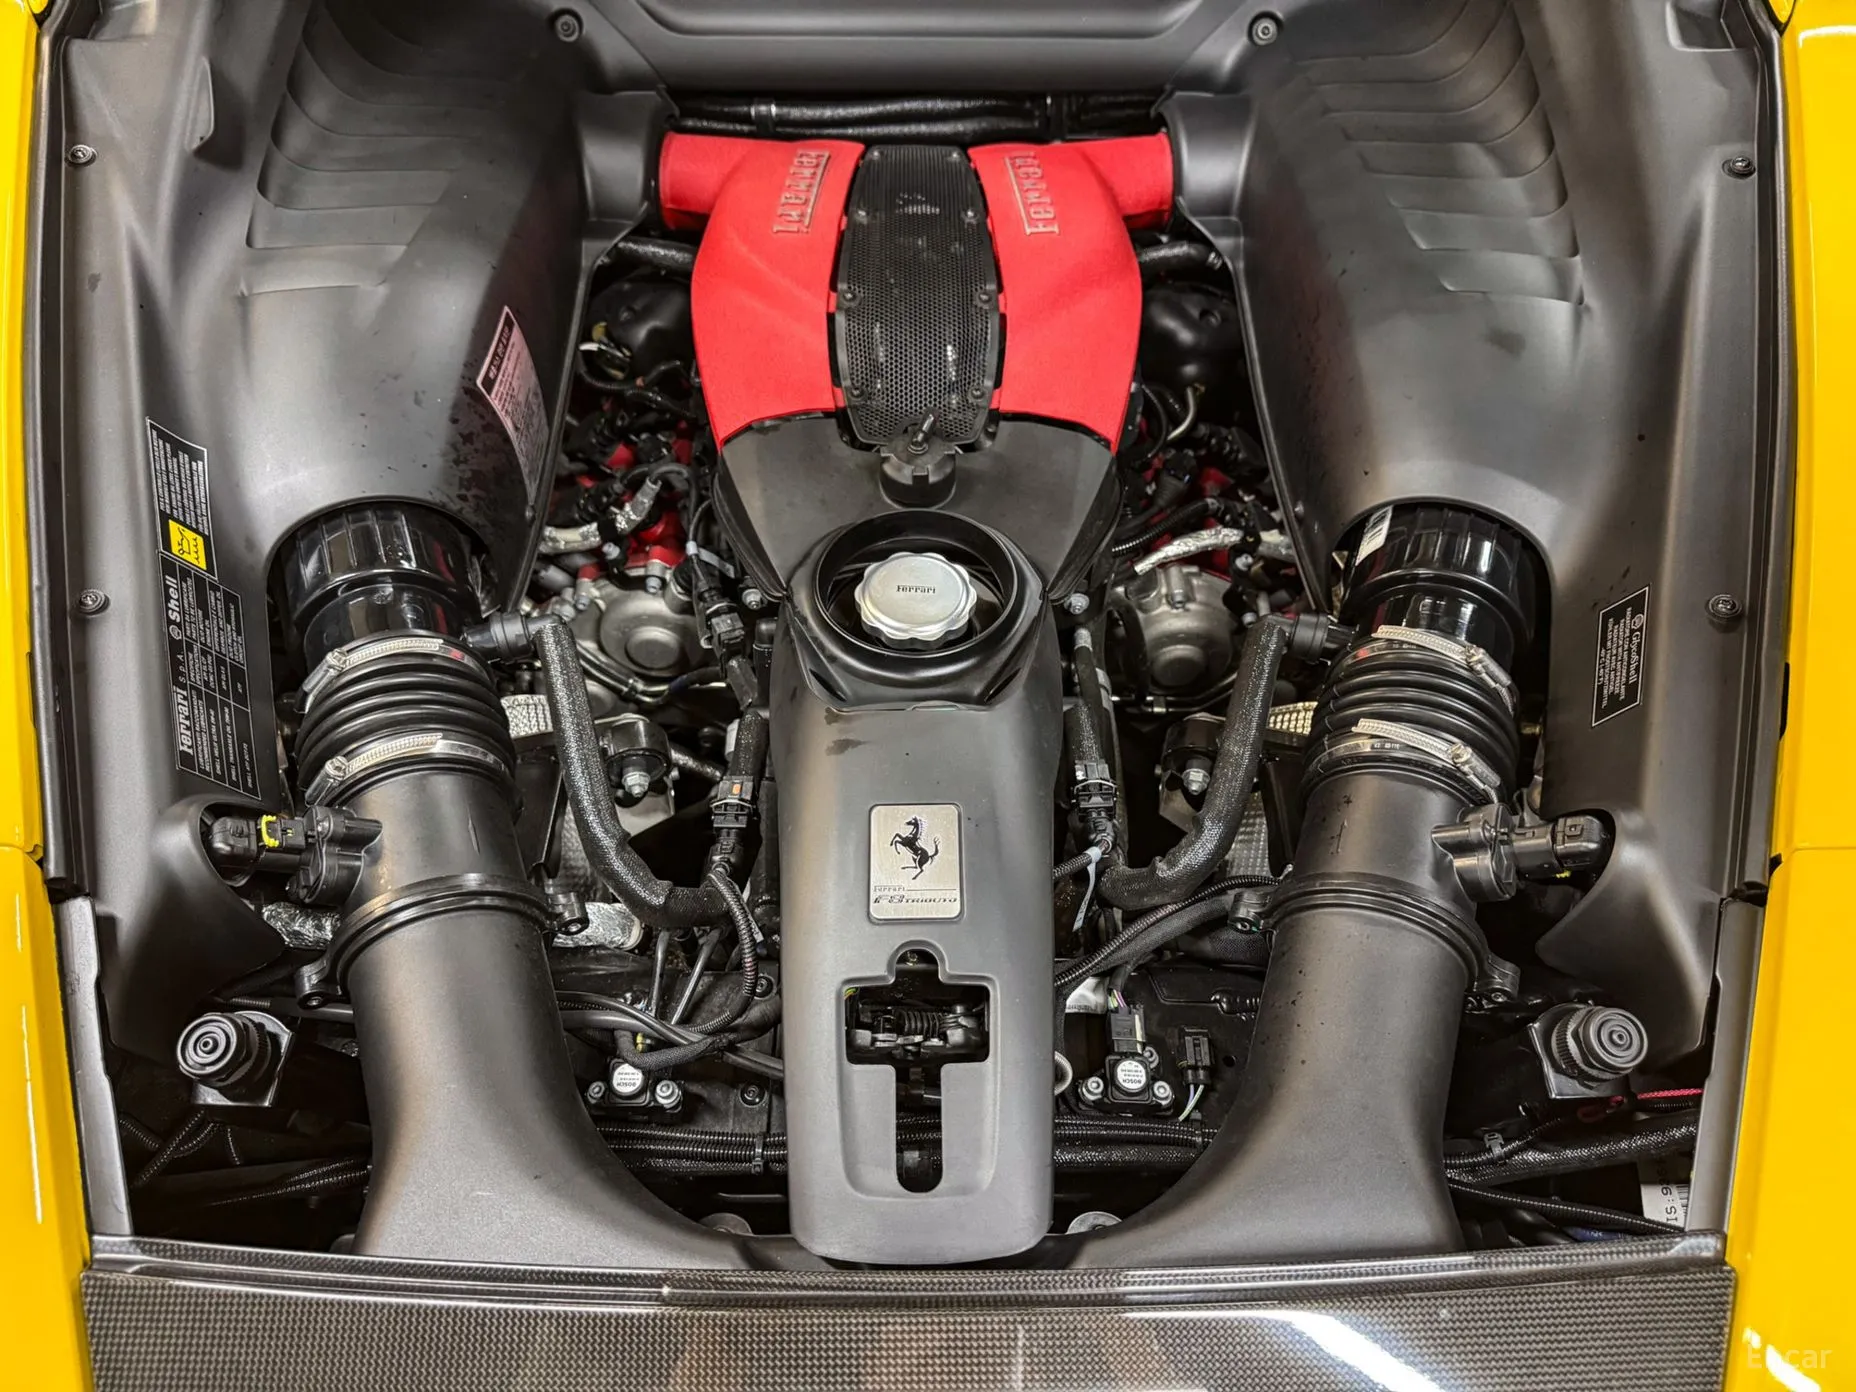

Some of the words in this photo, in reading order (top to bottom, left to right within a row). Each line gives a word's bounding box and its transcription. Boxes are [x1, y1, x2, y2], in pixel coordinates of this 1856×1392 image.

[773, 149, 831, 234] Ferrari
[1004, 151, 1060, 236] Ferrari
[164, 573, 180, 624] Shell
[896, 584, 936, 594] Ferrari
[1626, 629, 1641, 685] GlycoShell
[173, 684, 193, 755] Ferrari
